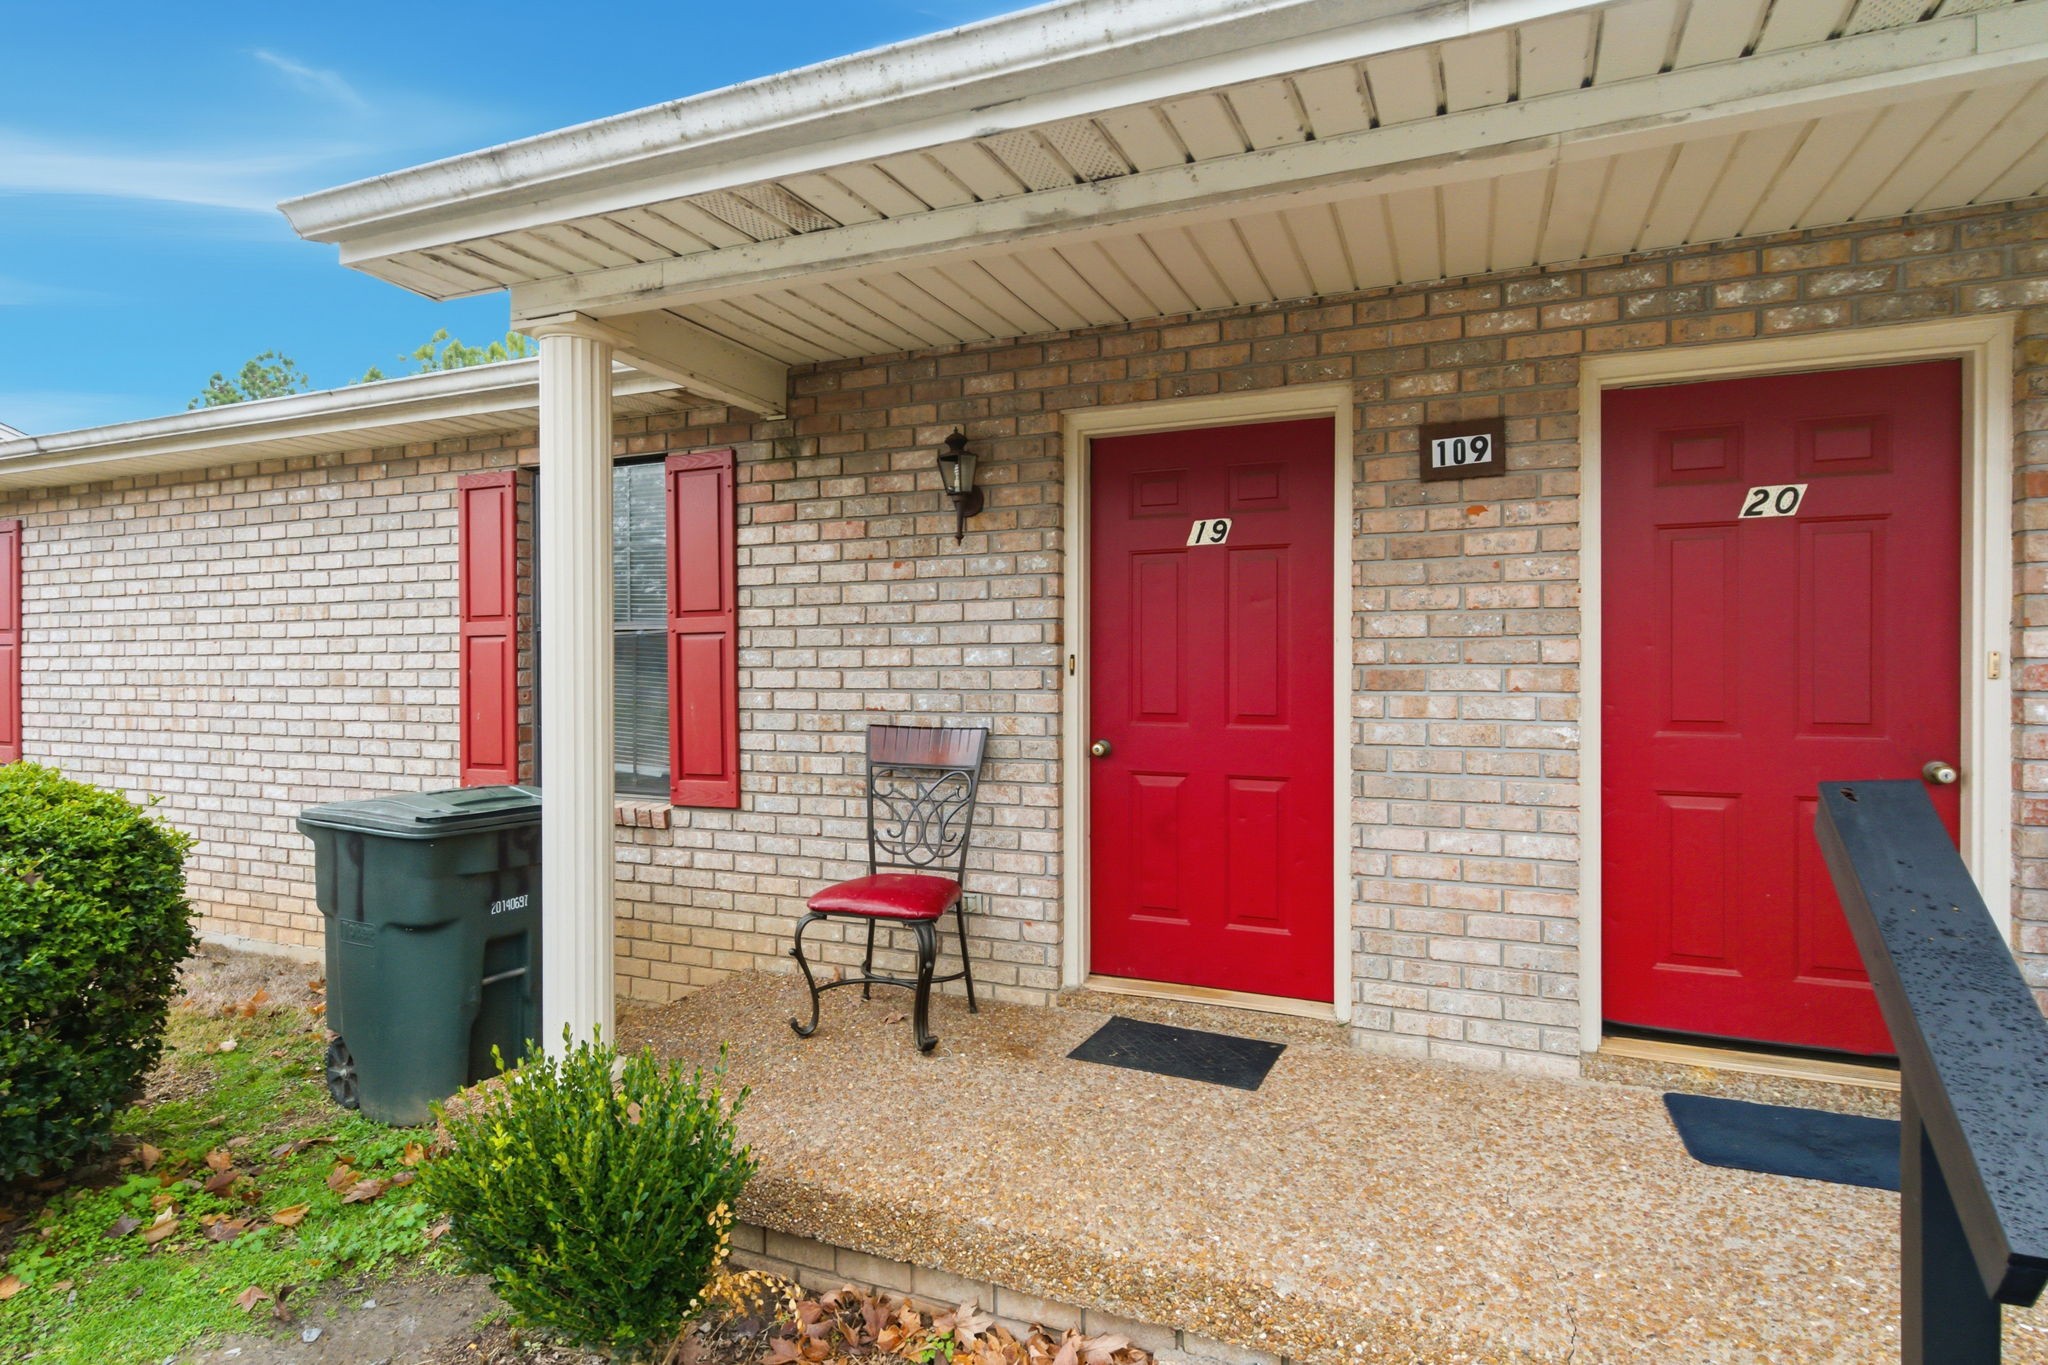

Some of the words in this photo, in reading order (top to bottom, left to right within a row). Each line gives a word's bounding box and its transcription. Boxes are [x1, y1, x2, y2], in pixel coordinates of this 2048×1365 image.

[1436, 435, 1489, 467] 109
[1743, 486, 1800, 517] 20
[1195, 519, 1228, 544] 19
